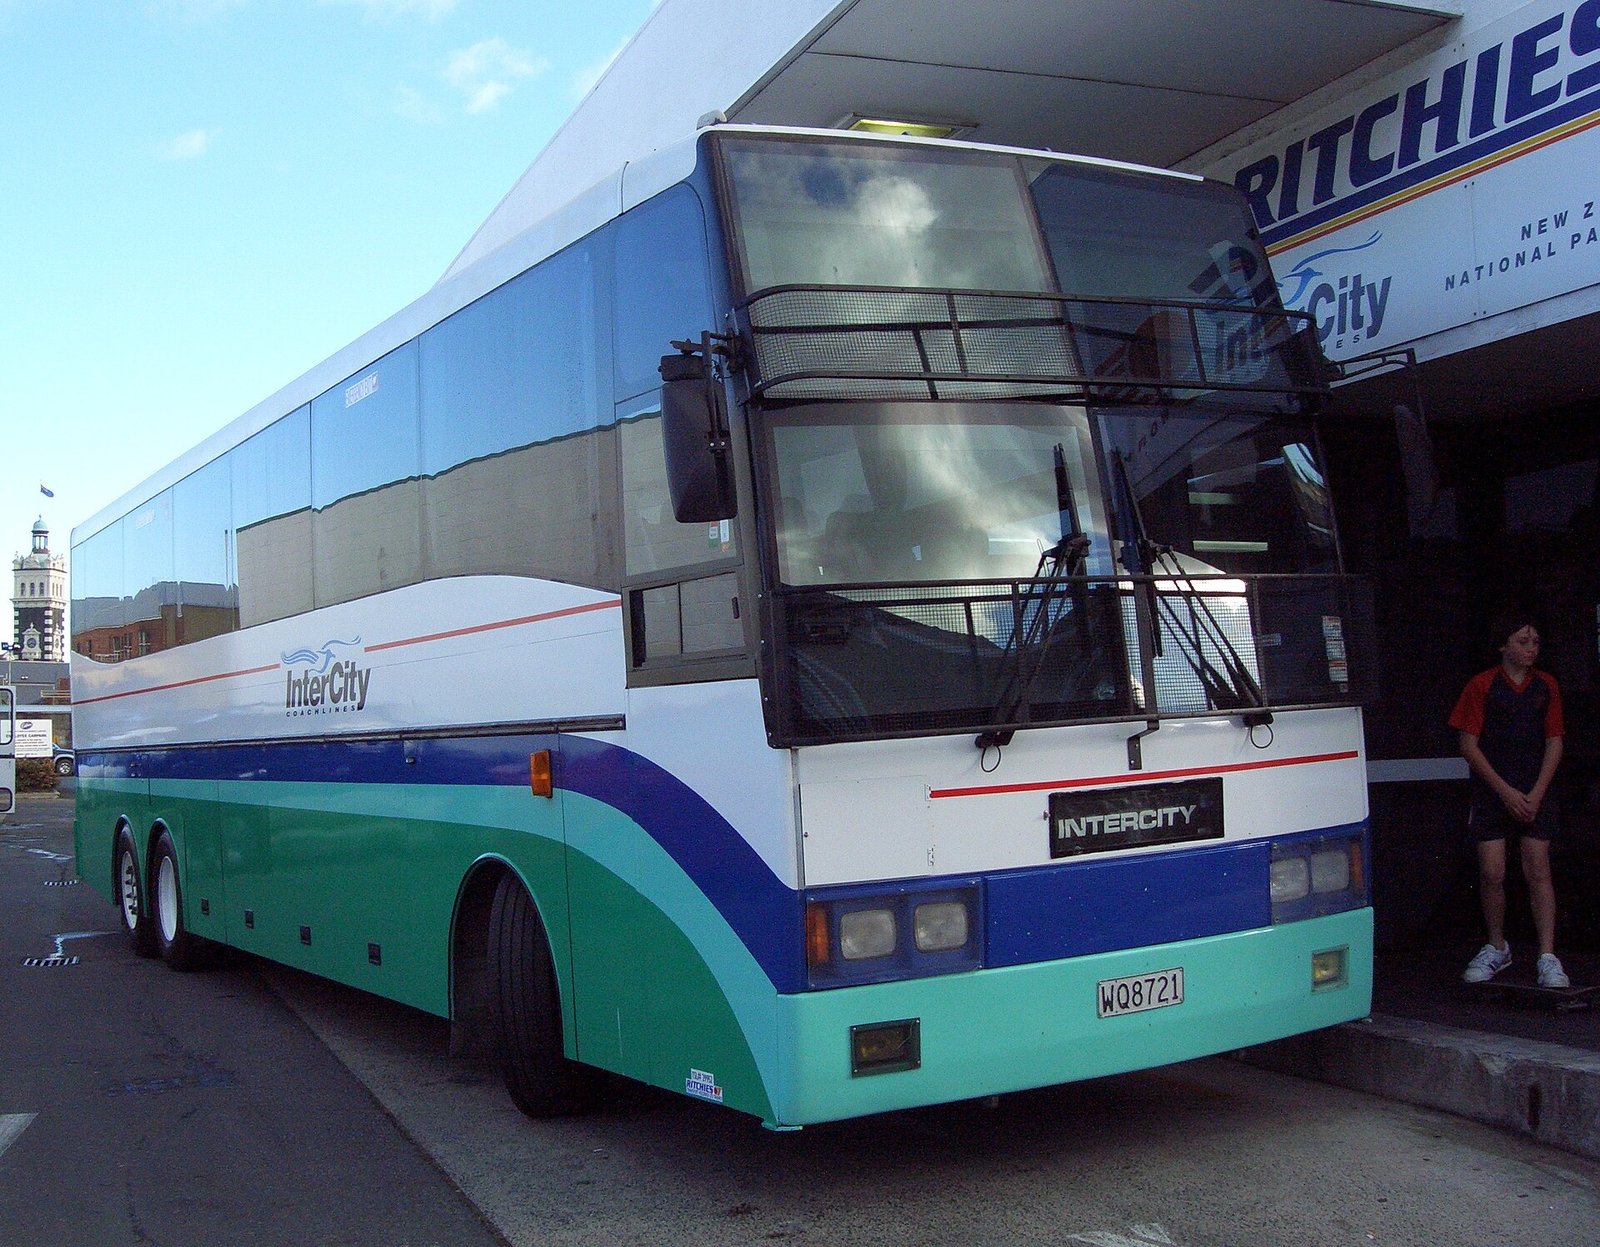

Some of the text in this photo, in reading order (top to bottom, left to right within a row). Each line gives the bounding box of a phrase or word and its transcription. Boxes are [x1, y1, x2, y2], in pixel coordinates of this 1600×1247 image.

[1235, 0, 1600, 230] RITCHIES
[1520, 210, 1569, 241] NEW
[1445, 241, 1557, 291] NATIONAL
[286, 660, 371, 711] InterCity
[285, 705, 356, 718] COACHLINES
[1058, 805, 1197, 839] INTERCITY
[1101, 973, 1179, 1013] WQ8721
[686, 1079, 714, 1094] RITCHIES
